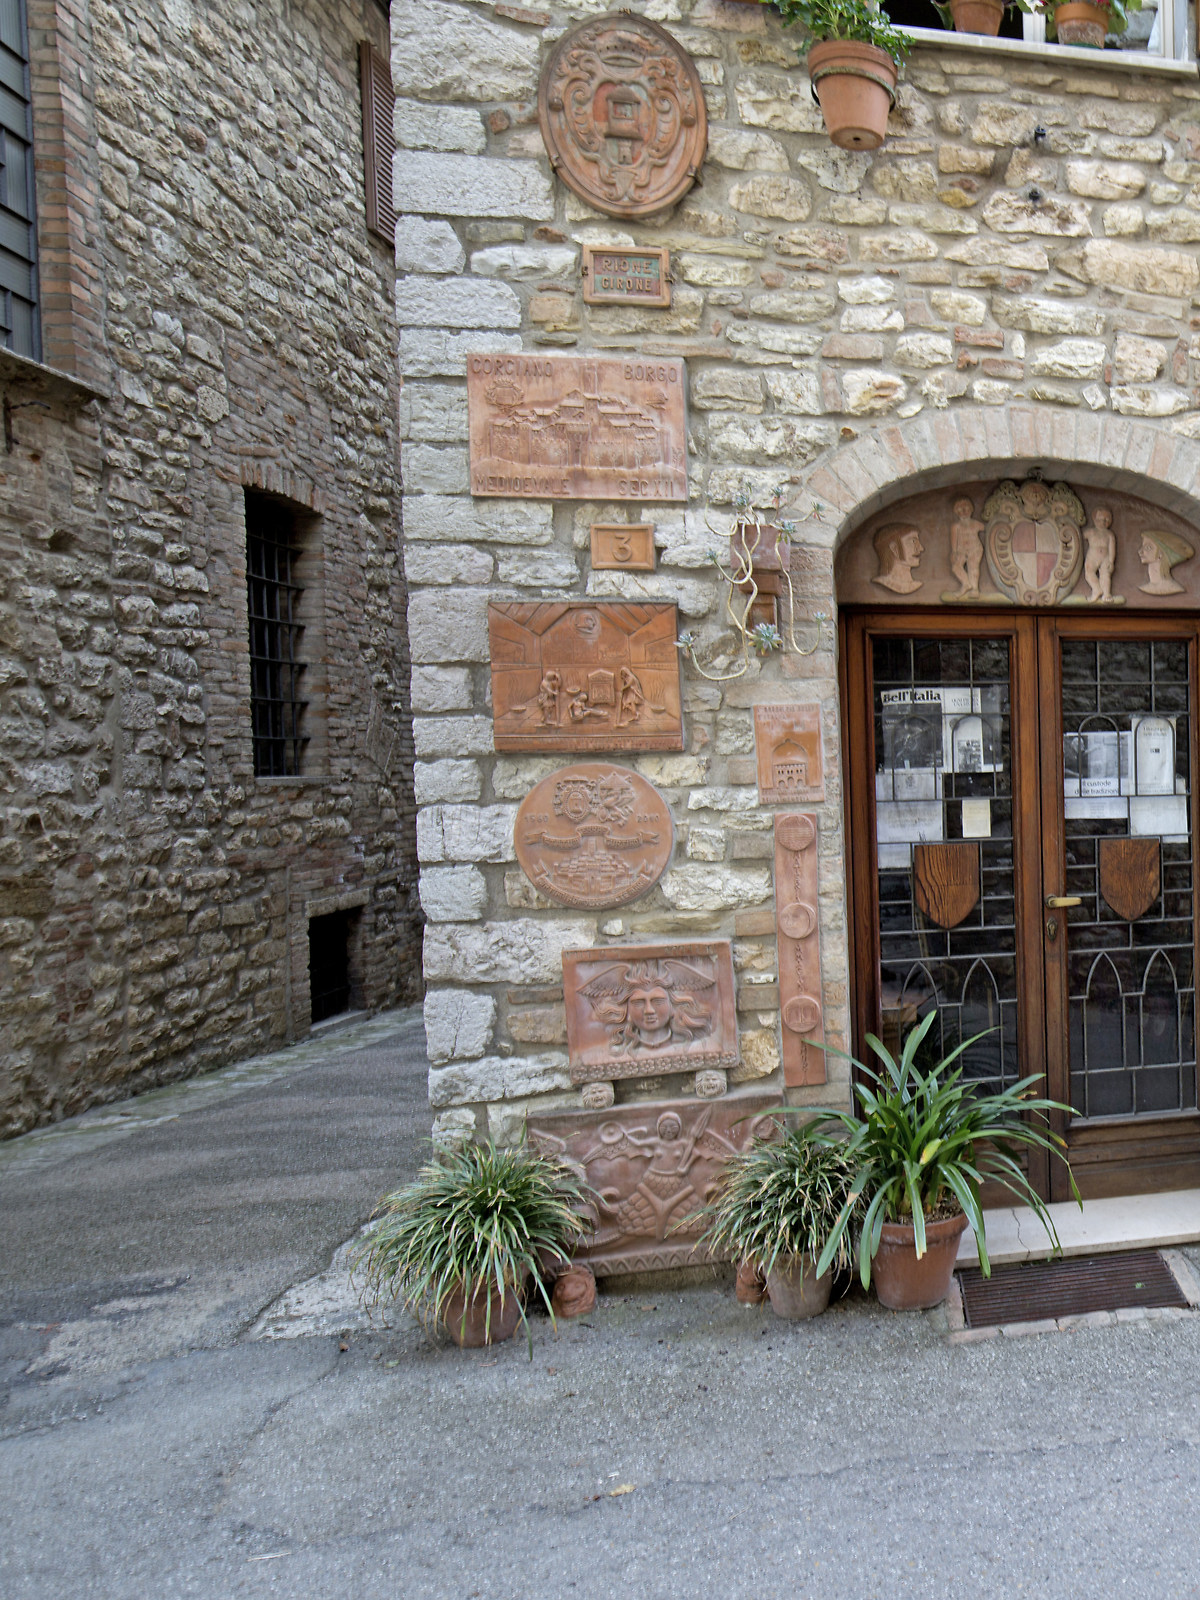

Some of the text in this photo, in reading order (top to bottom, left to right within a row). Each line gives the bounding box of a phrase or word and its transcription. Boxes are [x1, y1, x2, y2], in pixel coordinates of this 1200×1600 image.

[602, 259, 653, 274] RIONE
[602, 277, 653, 291] GIRONE
[472, 358, 679, 383] CORCIANO BORGO
[475, 474, 571, 495] MEDIOEVALE
[612, 533, 633, 562] 3
